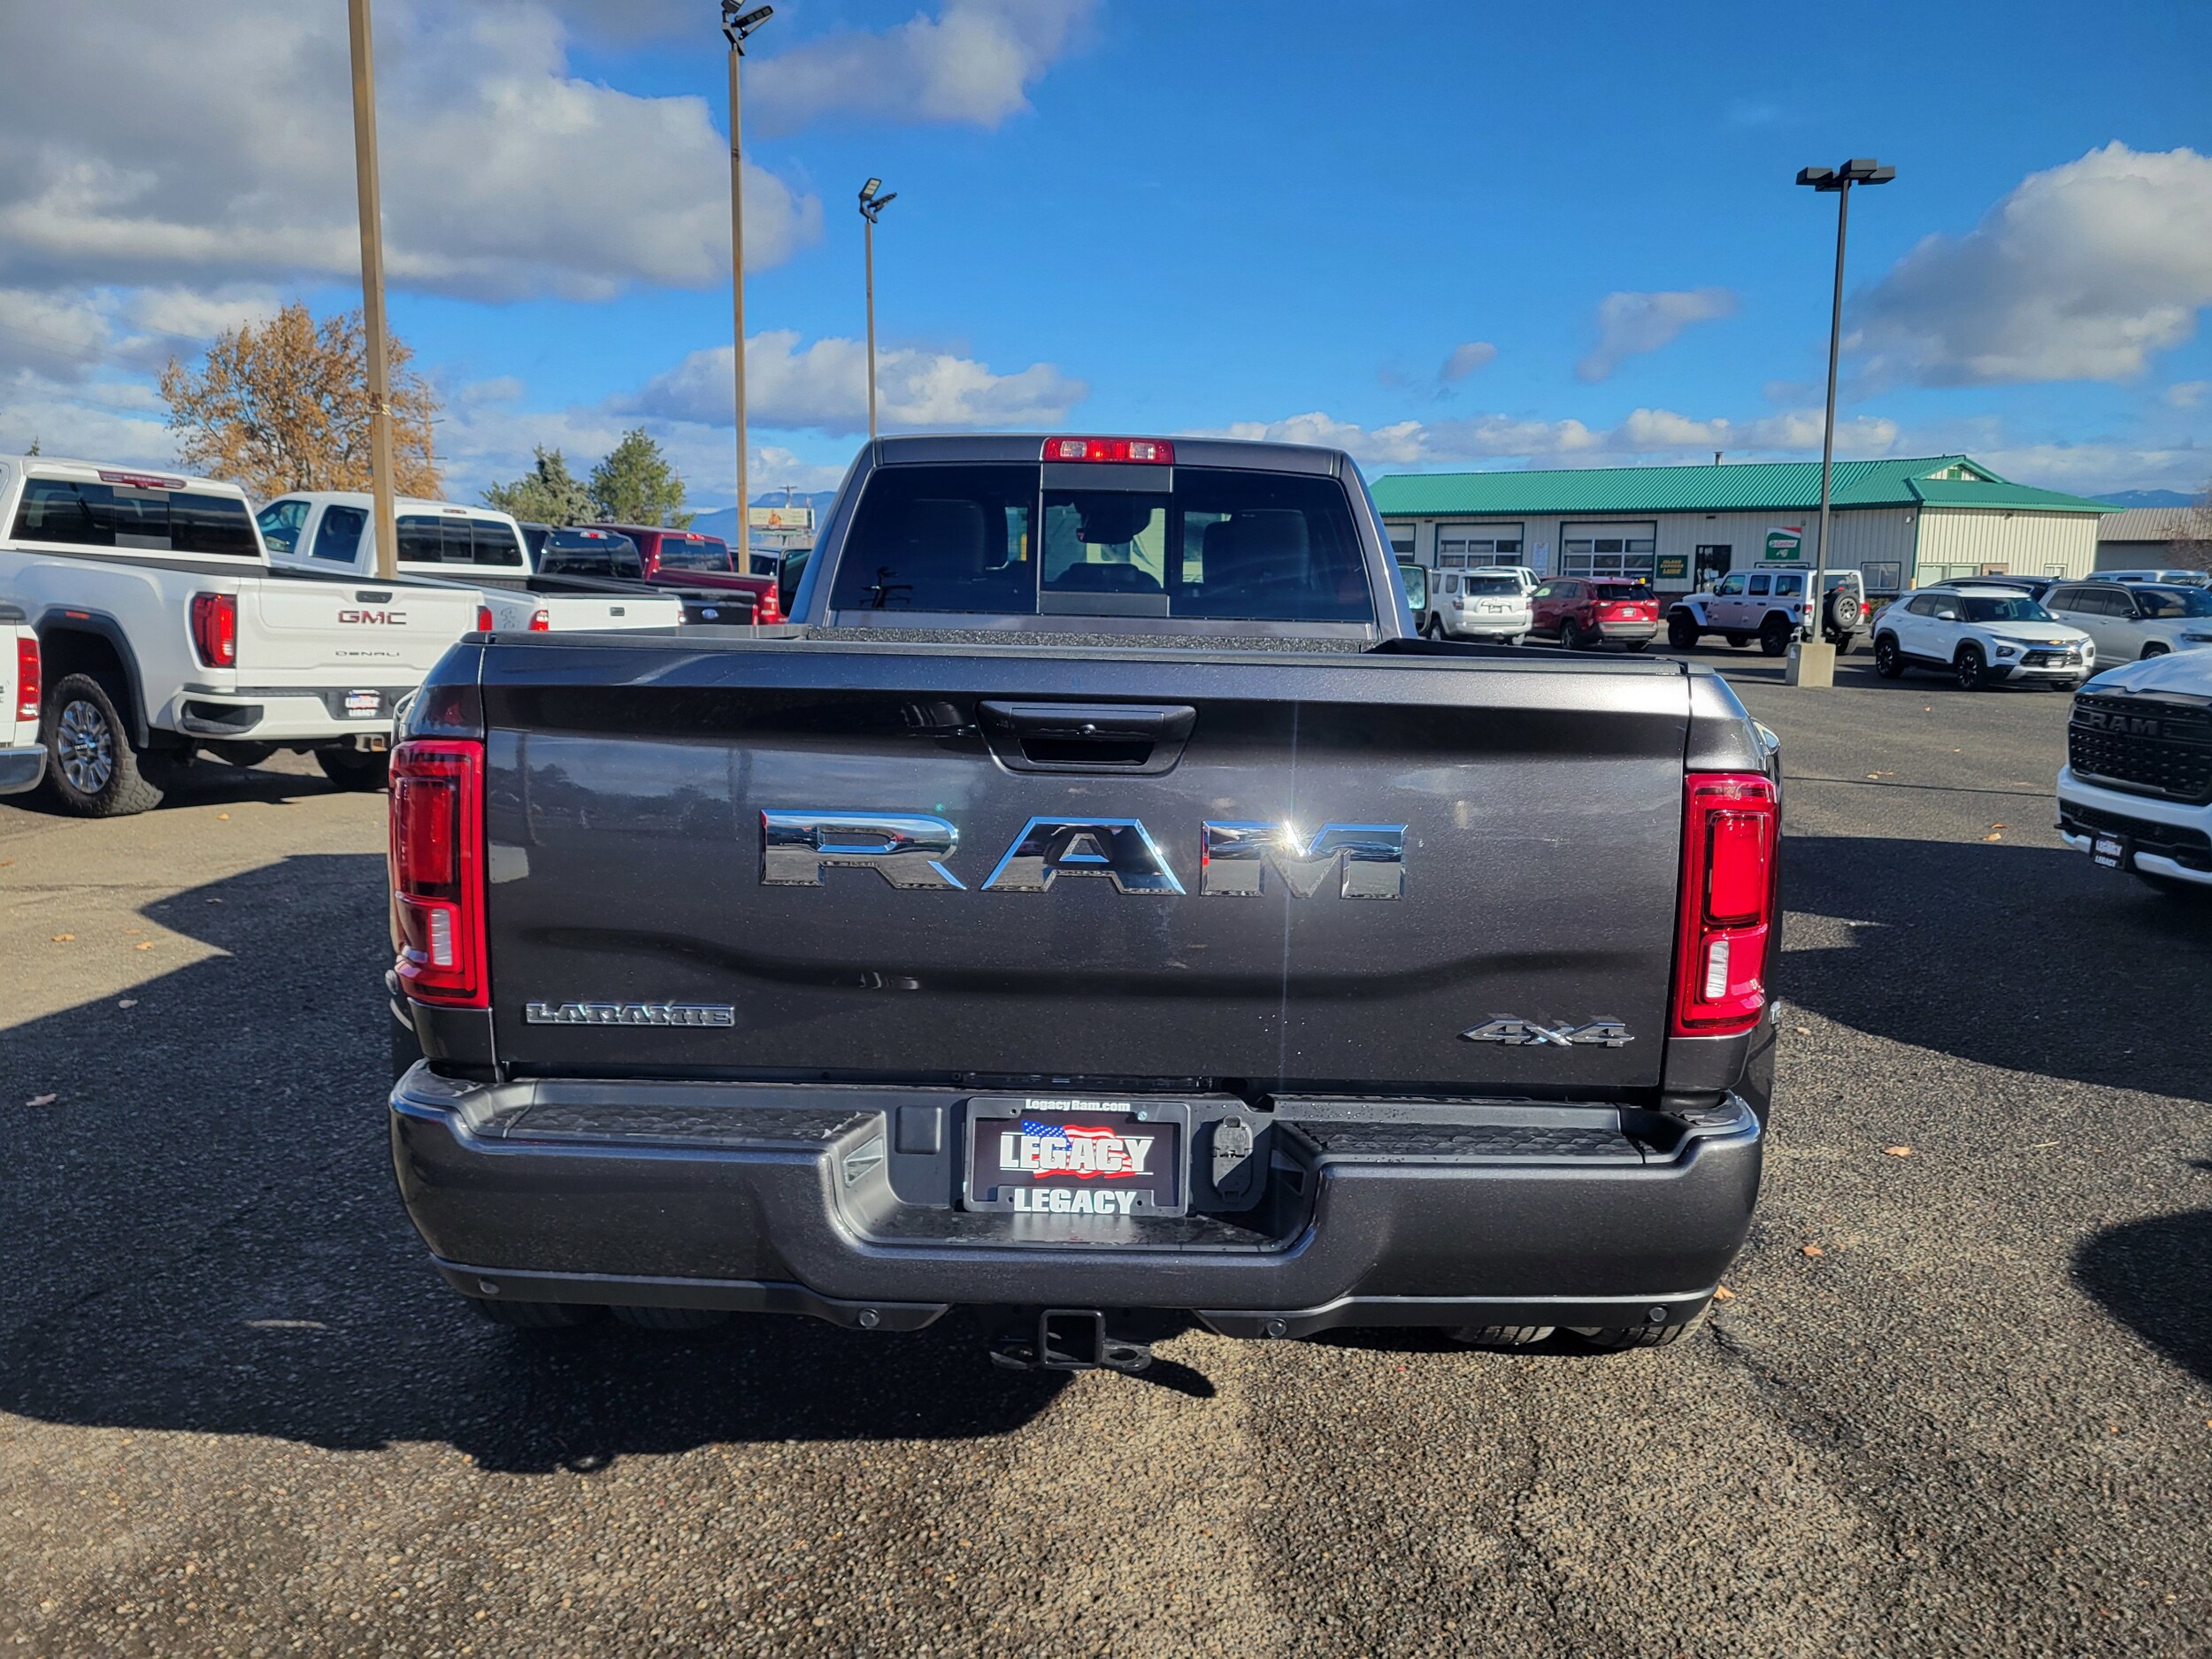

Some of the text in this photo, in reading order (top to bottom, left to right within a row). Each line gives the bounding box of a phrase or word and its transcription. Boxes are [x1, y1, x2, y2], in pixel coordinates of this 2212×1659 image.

[339, 611, 406, 625] GMC
[2089, 711, 2158, 736] RAM
[758, 809, 1409, 900] RAM
[526, 1002, 735, 1027] LARAMIE
[1000, 1134, 1154, 1172] LEGACY
[1013, 1188, 1137, 1215] LEGACY
